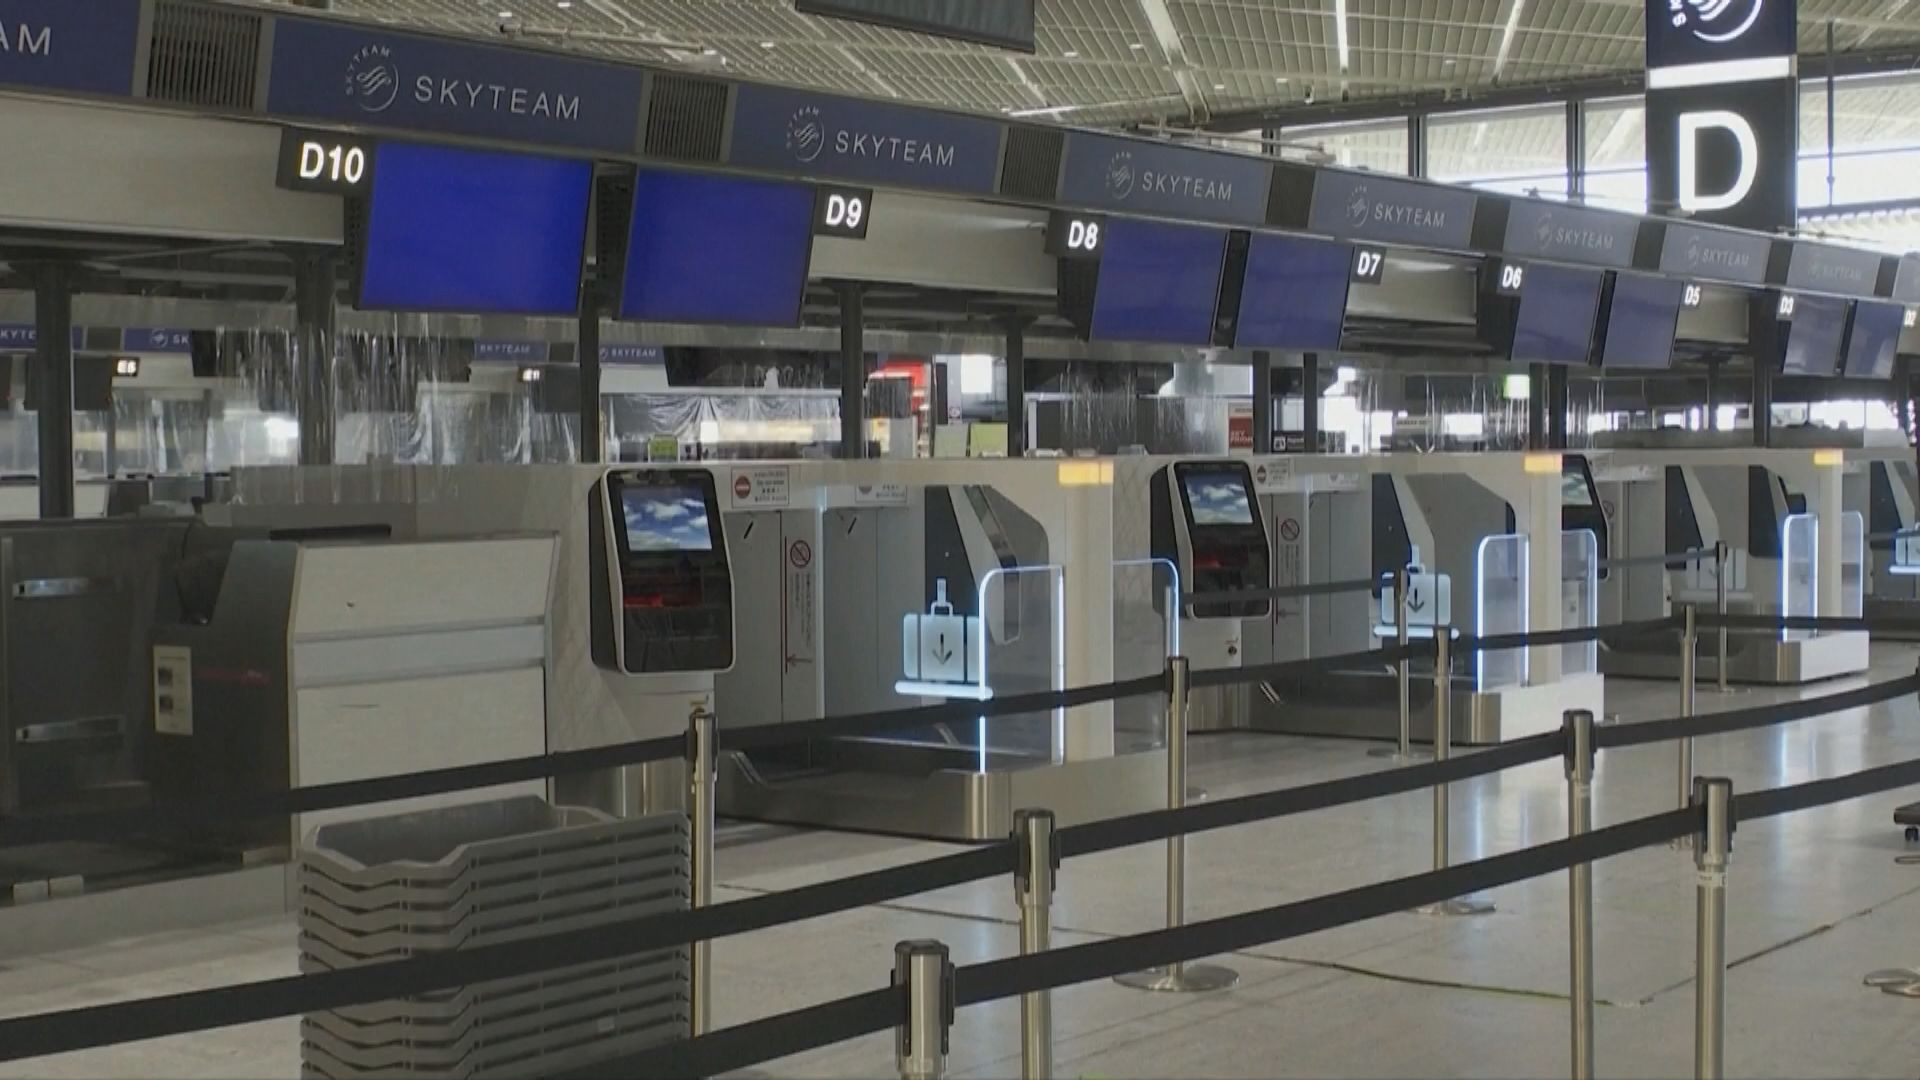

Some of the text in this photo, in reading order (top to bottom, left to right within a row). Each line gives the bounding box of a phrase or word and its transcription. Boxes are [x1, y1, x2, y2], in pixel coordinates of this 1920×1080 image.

[414, 75, 581, 121] SKYTEAM
[299, 140, 366, 184] D10
[835, 129, 956, 168] SKYTEAM
[1679, 110, 1758, 211] D
[1142, 171, 1233, 201] SKYTEAM
[825, 193, 863, 229] D9
[1374, 202, 1446, 229] SKYTEAM
[1067, 219, 1099, 250] D8
[1556, 226, 1614, 250] SKYTEAM
[1356, 251, 1381, 277] D7
[1702, 247, 1750, 268] SKYTEAM
[1502, 265, 1523, 290] D6
[1684, 283, 1701, 307] D5
[479, 343, 531, 355] SKYTEAM
[611, 347, 657, 358] SKYTEAM
